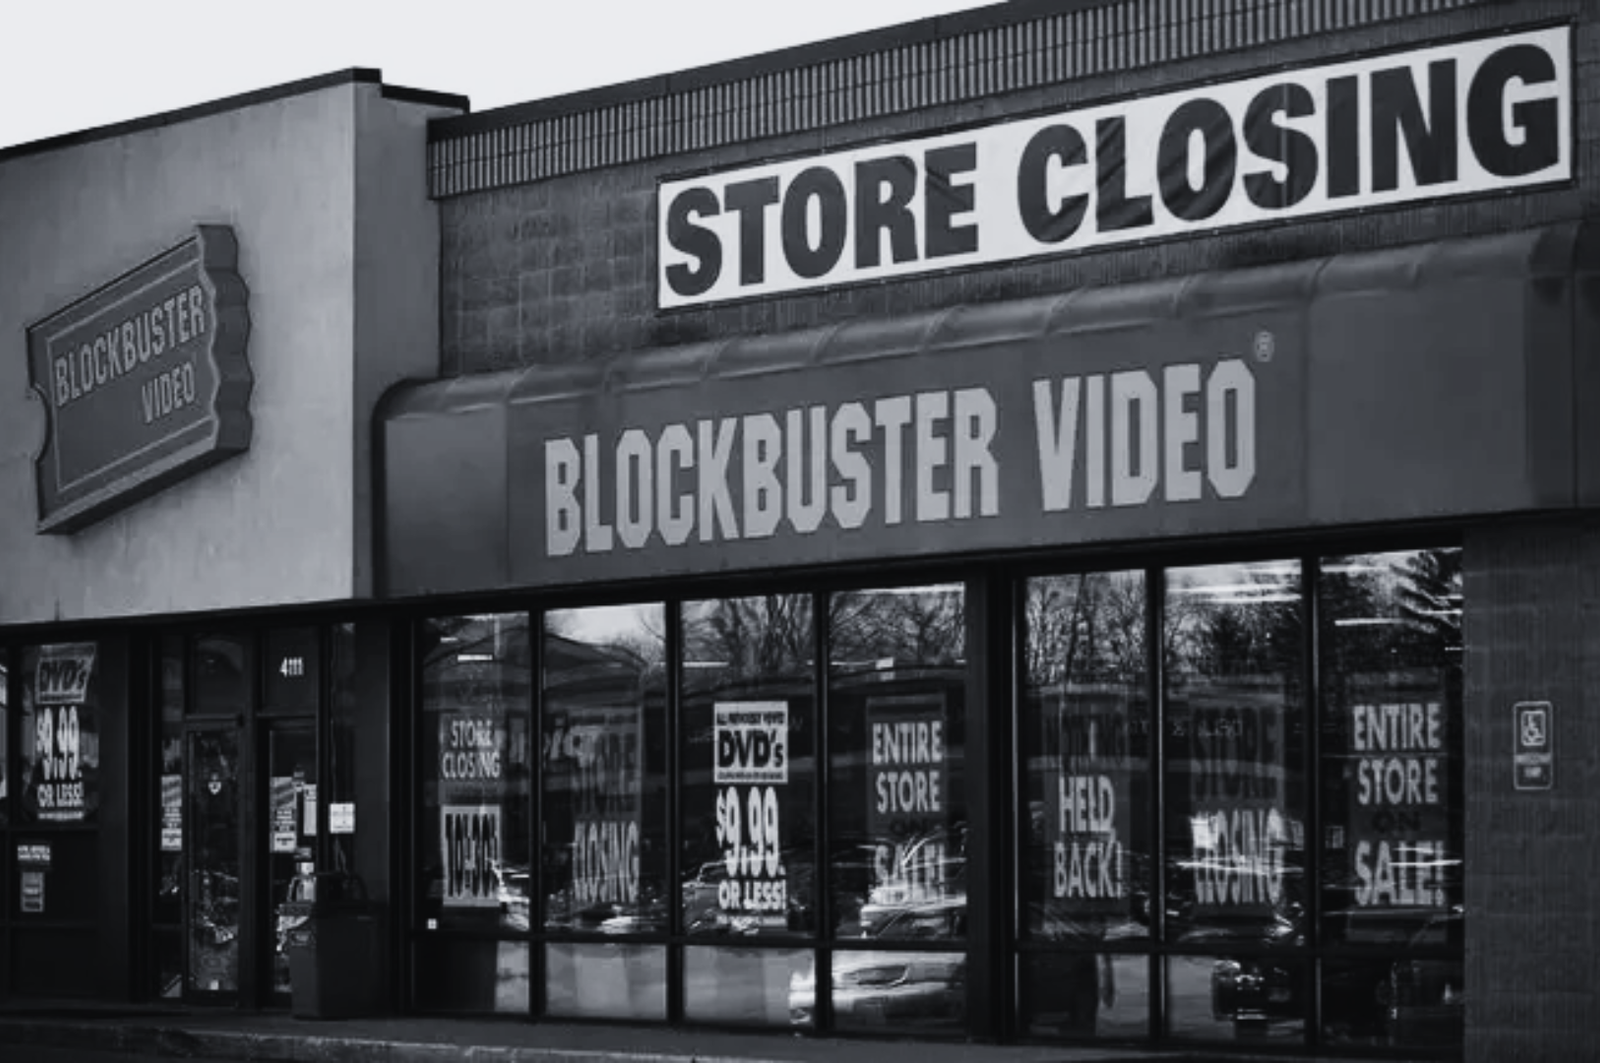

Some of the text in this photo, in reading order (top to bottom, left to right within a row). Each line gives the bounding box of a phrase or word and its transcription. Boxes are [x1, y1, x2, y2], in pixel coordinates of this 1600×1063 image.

[664, 42, 1560, 297] STORE CLOSING
[54, 285, 206, 407] BLOCKBUSTER
[141, 361, 196, 424] VIDEO
[545, 386, 1000, 557] BLOCKBUSTER
[1032, 358, 1256, 513] VIDEO
[279, 656, 304, 677] 4111
[451, 719, 493, 748] STORE
[719, 729, 784, 768] DVD's
[872, 720, 943, 765] ENTIRE
[1352, 703, 1441, 751] ENTIRE
[443, 751, 500, 779] CLOSING
[1357, 757, 1439, 805] STORE
[875, 770, 941, 815] STORE
[1058, 775, 1114, 833] HELD
[1053, 838, 1123, 898] BACK!
[1354, 840, 1445, 907] SALE!
[718, 879, 786, 910] OR LESS!
